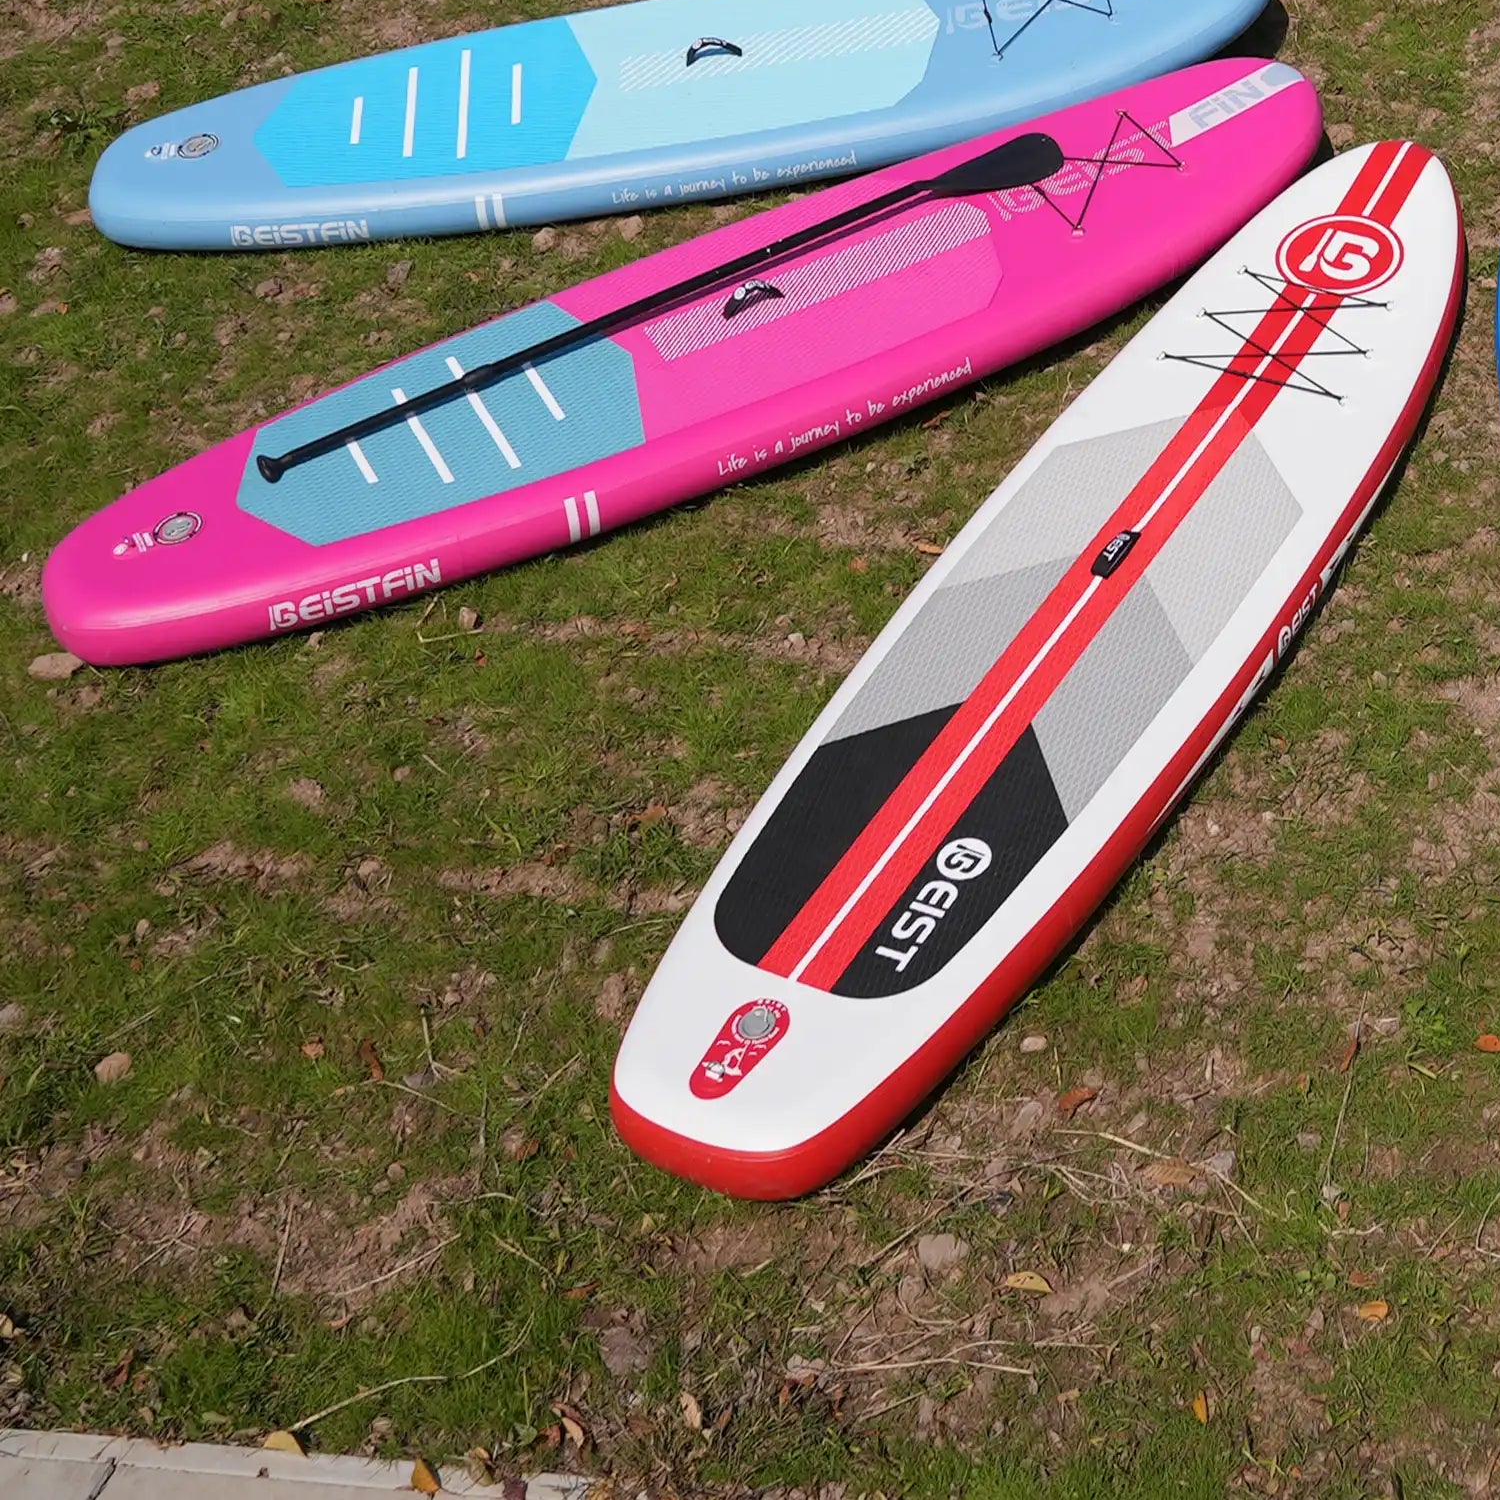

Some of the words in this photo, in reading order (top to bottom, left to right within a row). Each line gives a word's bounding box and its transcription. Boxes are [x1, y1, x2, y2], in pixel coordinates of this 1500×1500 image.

[612, 192, 638, 204] Life
[645, 189, 656, 199] is
[664, 185, 673, 196] a
[679, 177, 726, 198] journey
[732, 172, 746, 186] to
[753, 167, 769, 181] be
[777, 151, 856, 179] experienced
[717, 454, 748, 476] Life
[755, 446, 767, 462] is
[775, 442, 783, 453] a
[788, 421, 841, 453] journey
[847, 409, 862, 424] to
[868, 400, 885, 416] be
[892, 356, 972, 407] experienced
